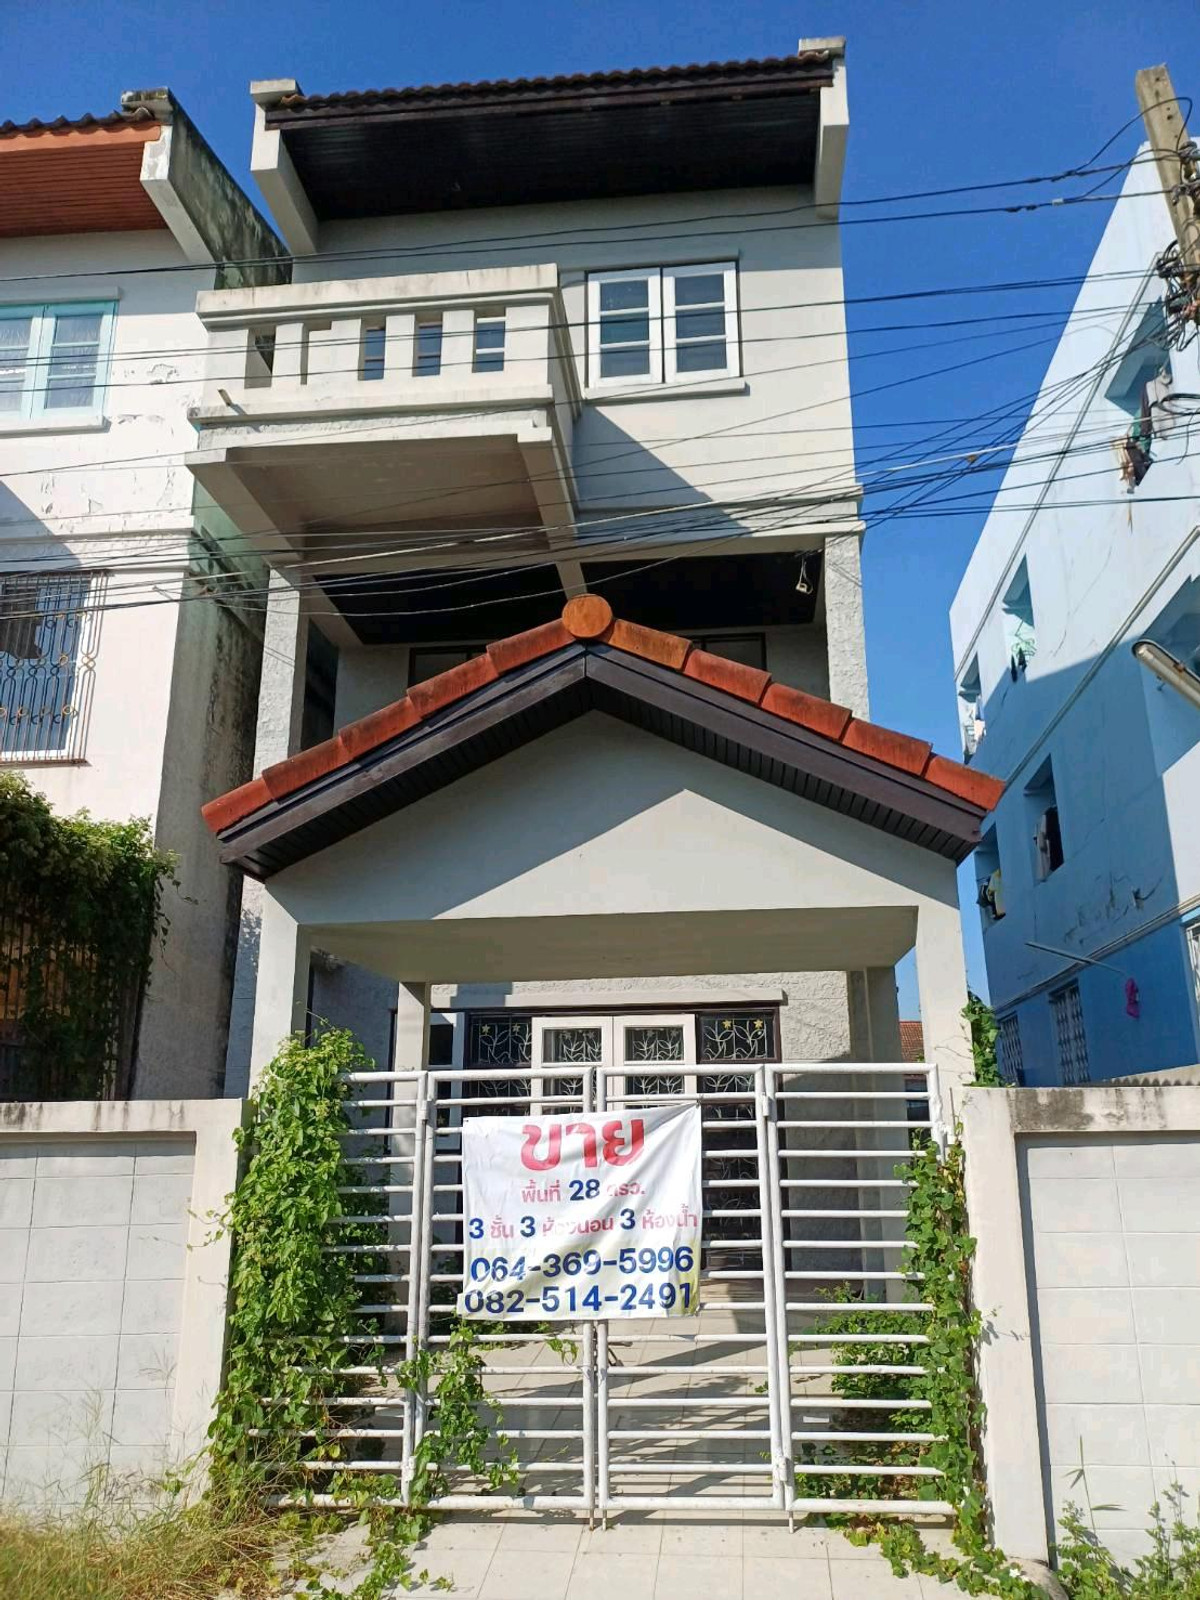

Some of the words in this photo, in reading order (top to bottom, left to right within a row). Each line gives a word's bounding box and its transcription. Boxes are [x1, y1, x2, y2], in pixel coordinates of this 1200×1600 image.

[520, 1118, 645, 1171] ขาย
[521, 1179, 561, 1203] พื้นที่
[568, 1178, 600, 1201] 28
[468, 1217, 485, 1239] 3
[490, 1214, 514, 1239] ชั้น
[520, 1215, 536, 1238] 3
[620, 1208, 636, 1230] 3
[470, 1246, 694, 1282] 064-369-5996
[464, 1282, 691, 1314] 082-514-2491
